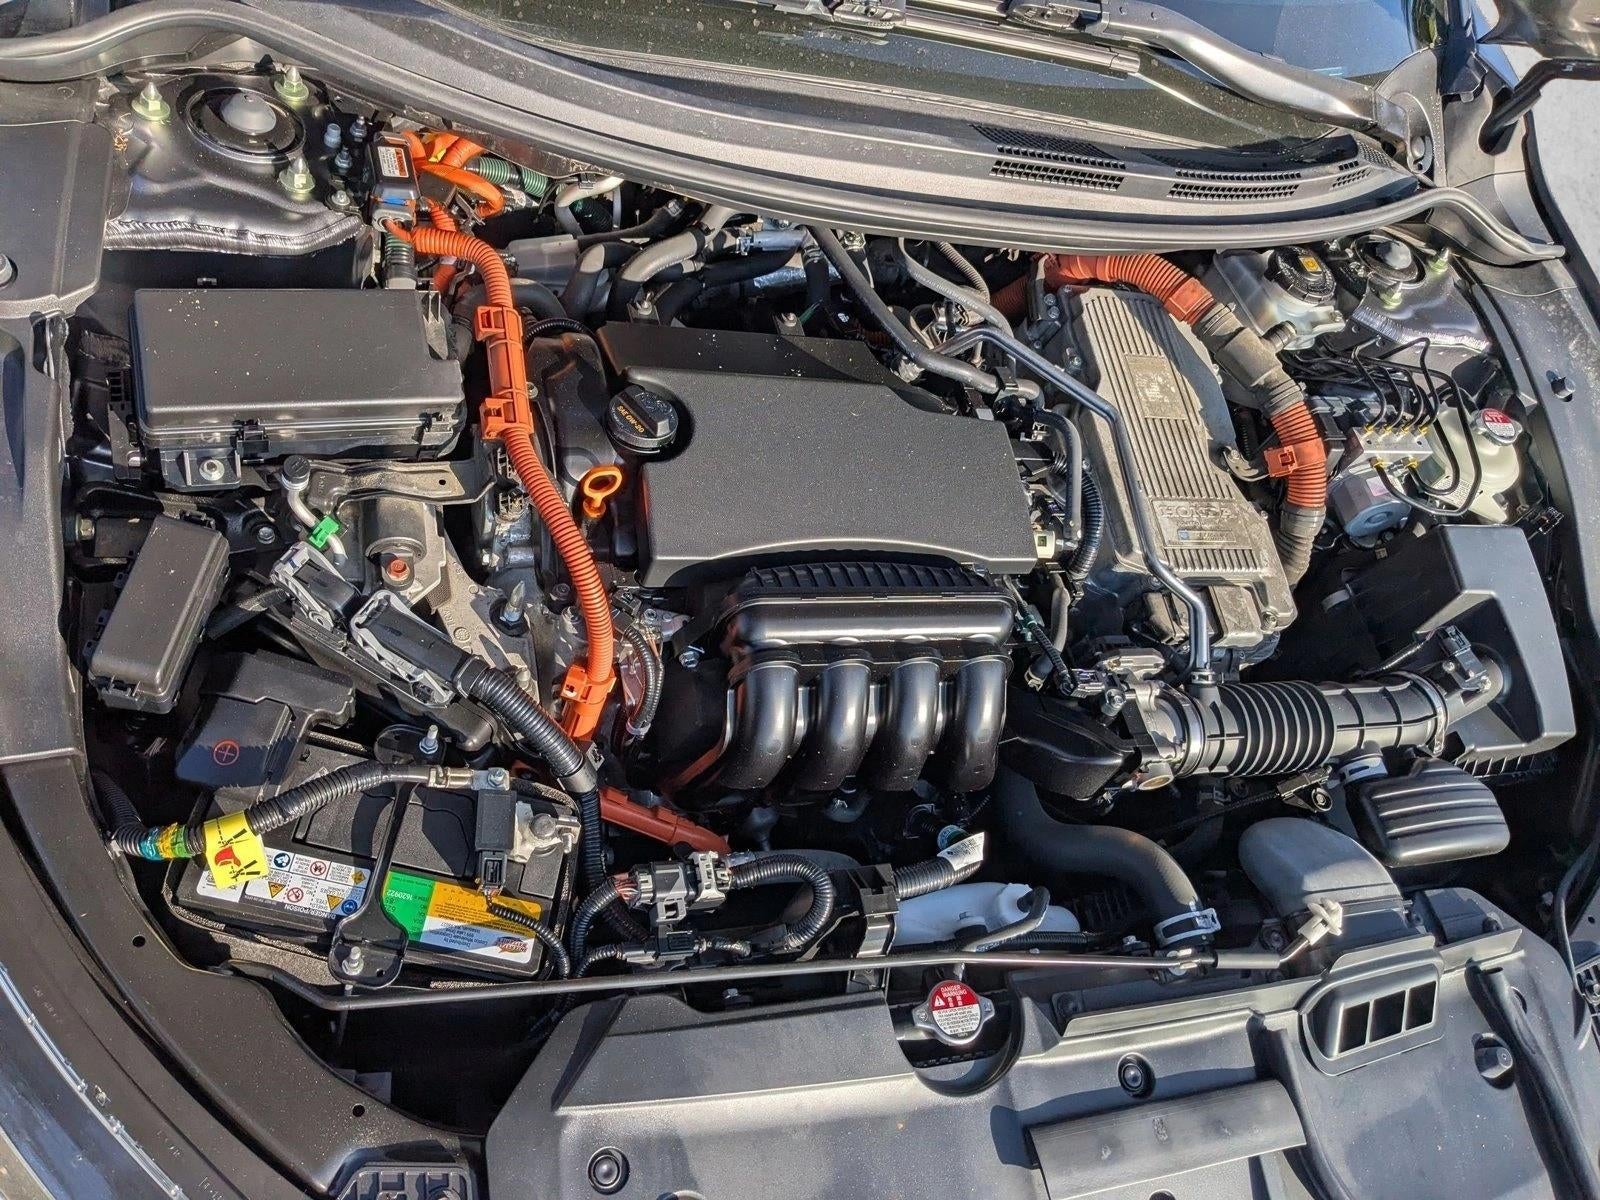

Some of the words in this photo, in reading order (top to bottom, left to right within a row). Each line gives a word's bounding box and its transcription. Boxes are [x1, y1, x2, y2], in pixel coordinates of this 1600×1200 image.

[616, 405, 630, 418] SAE
[626, 414, 645, 433] 0W-20
[1159, 505, 1237, 519] HONDA
[386, 890, 413, 900] 1620922
[284, 904, 336, 919] DANGER/POISON
[452, 934, 473, 942] Wholesale
[449, 939, 470, 948] Distributed
[942, 989, 967, 998] WARNING
